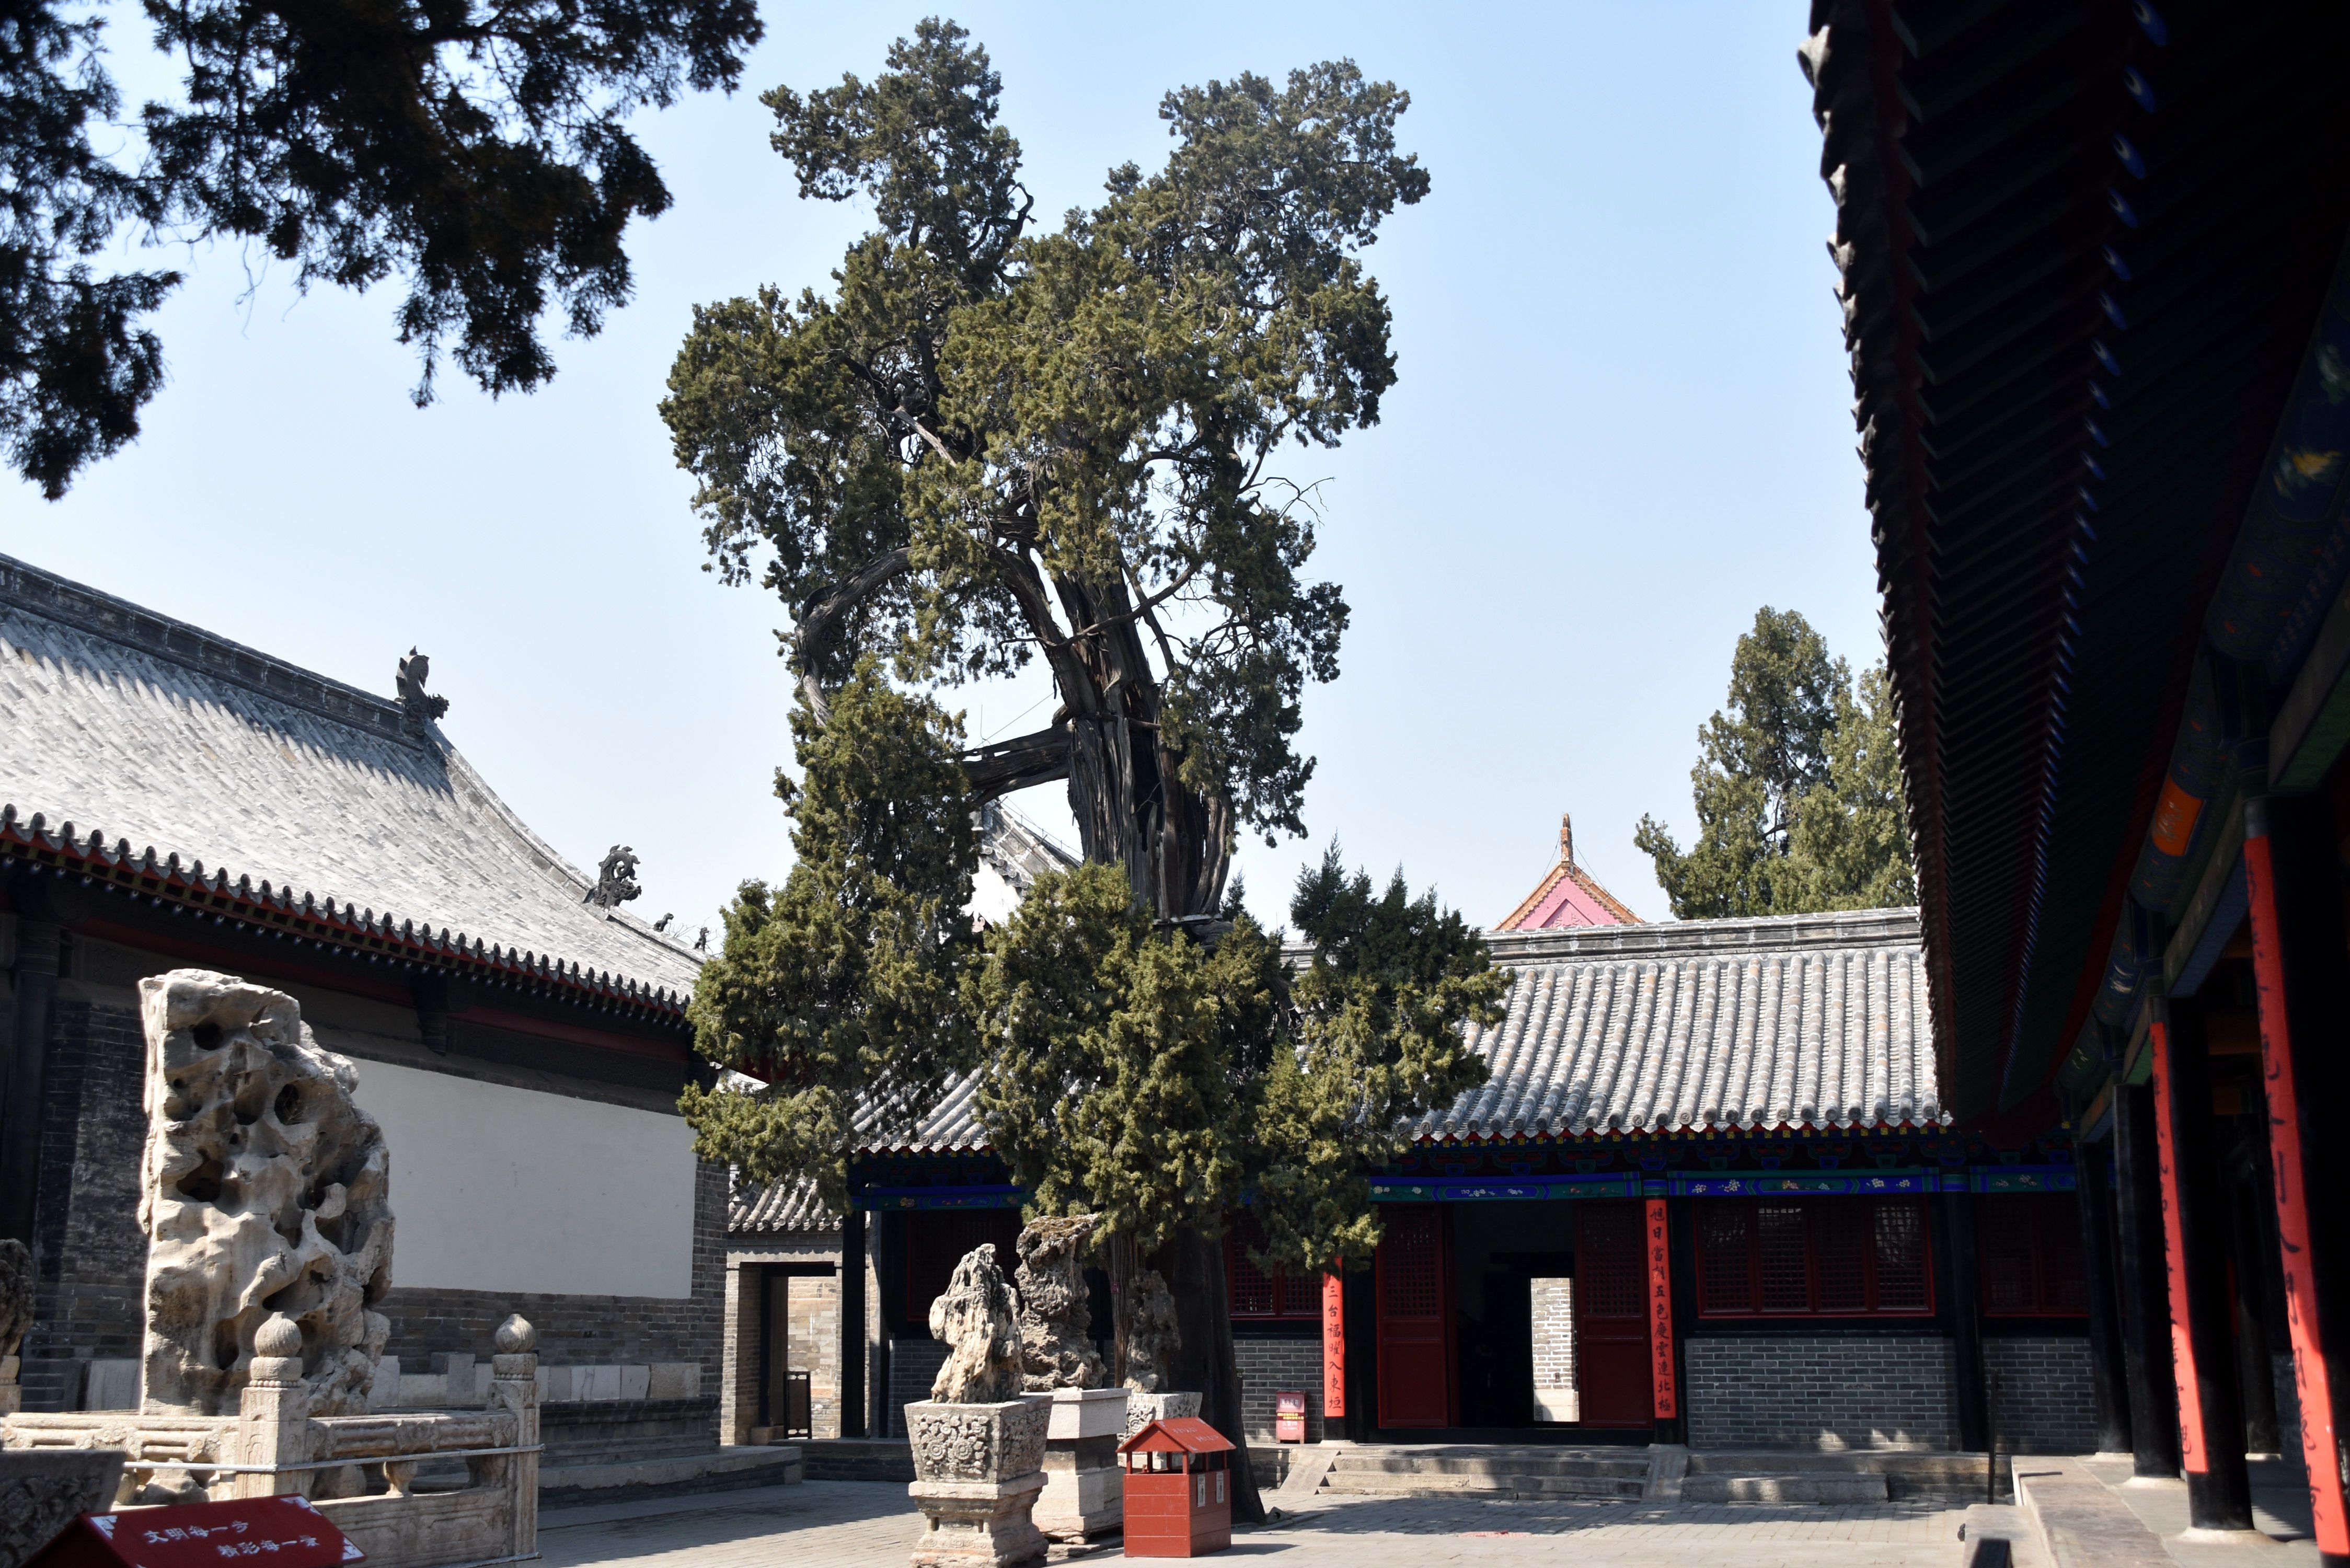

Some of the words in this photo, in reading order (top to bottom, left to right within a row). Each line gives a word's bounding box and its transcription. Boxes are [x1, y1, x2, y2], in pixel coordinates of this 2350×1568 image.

[1327, 1275, 1342, 1410] 三台福曜入東垣
[144, 1520, 249, 1543] 文明每一步
[217, 1535, 319, 1558] 精彩每一景
